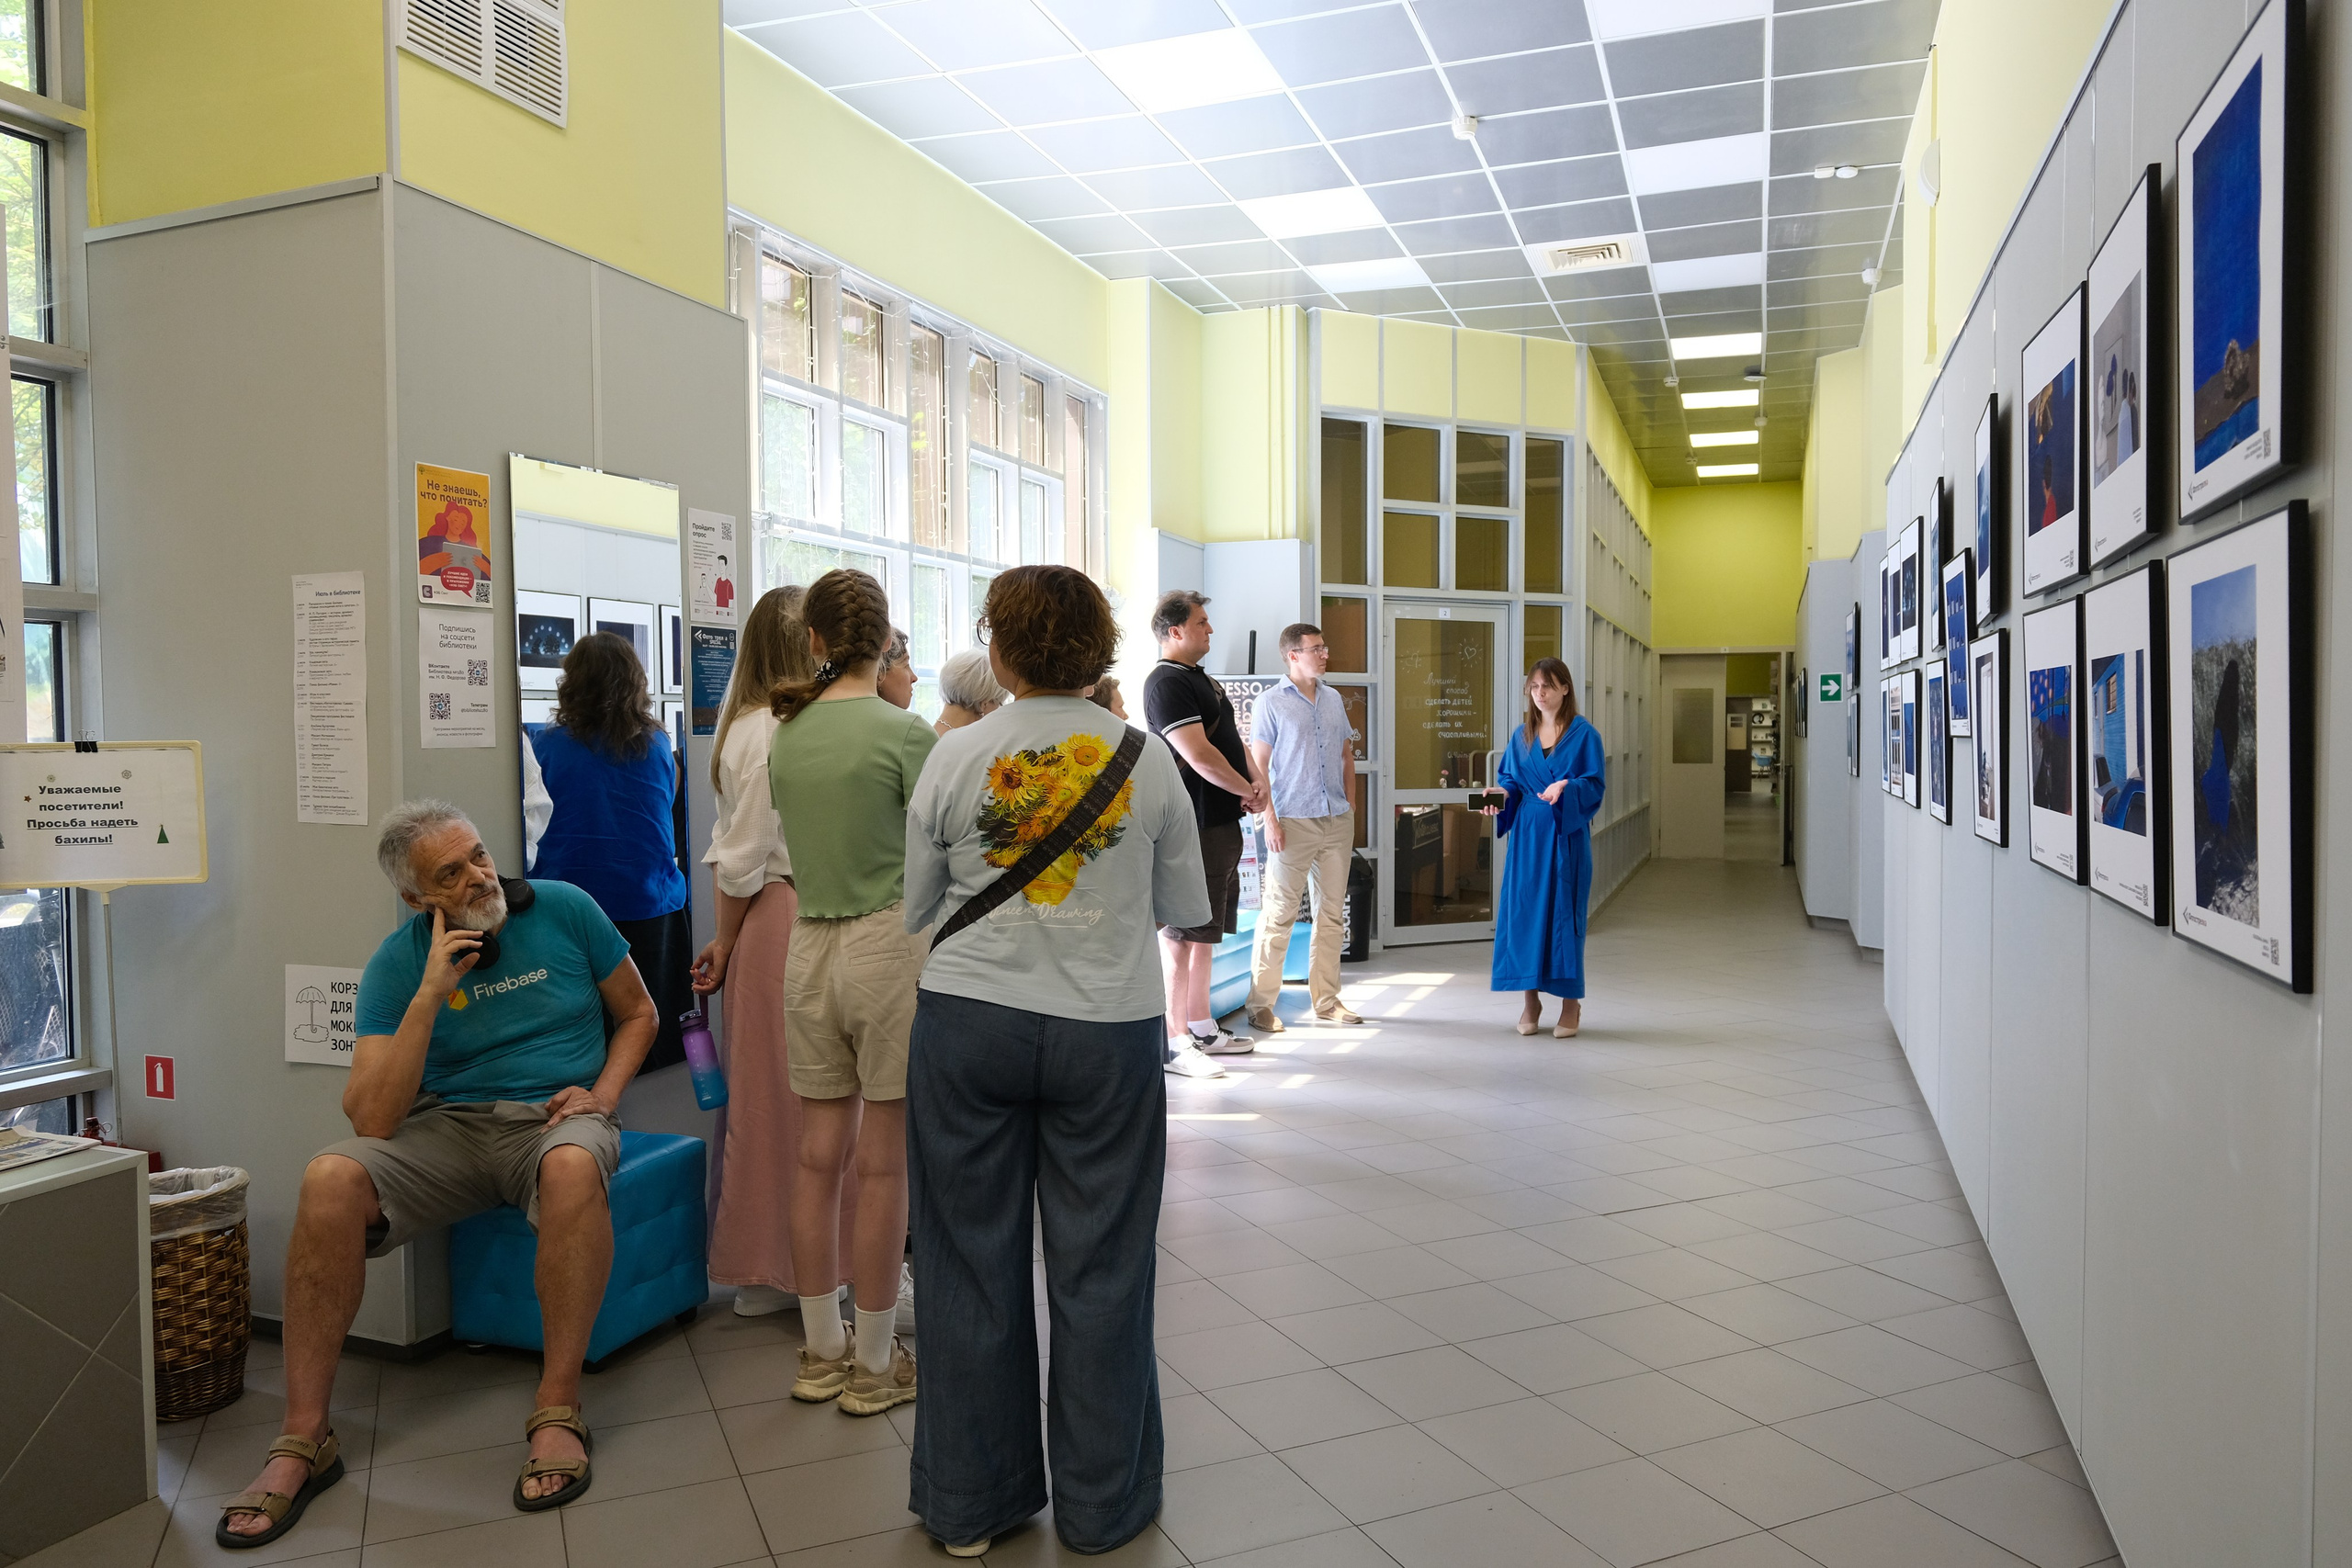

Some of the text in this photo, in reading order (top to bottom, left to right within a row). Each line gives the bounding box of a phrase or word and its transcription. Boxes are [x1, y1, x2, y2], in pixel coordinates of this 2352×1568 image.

[427, 479, 481, 498] Не знаешь,
[420, 491, 487, 508] что почитать?
[692, 523, 715, 532] Пройдите
[439, 624, 476, 633] Подпишись
[39, 786, 121, 794] Уважаемые
[39, 801, 123, 811] посетители!
[27, 818, 138, 829] Просьба надеть
[55, 835, 112, 844] бахилы!
[1037, 902, 1105, 925] Drawing
[331, 982, 358, 995] КОРЗ
[473, 968, 548, 1000] Firebase
[330, 1001, 352, 1014] ДЛЯ
[331, 1020, 356, 1033] МОК
[331, 1039, 356, 1052] ЗОН
